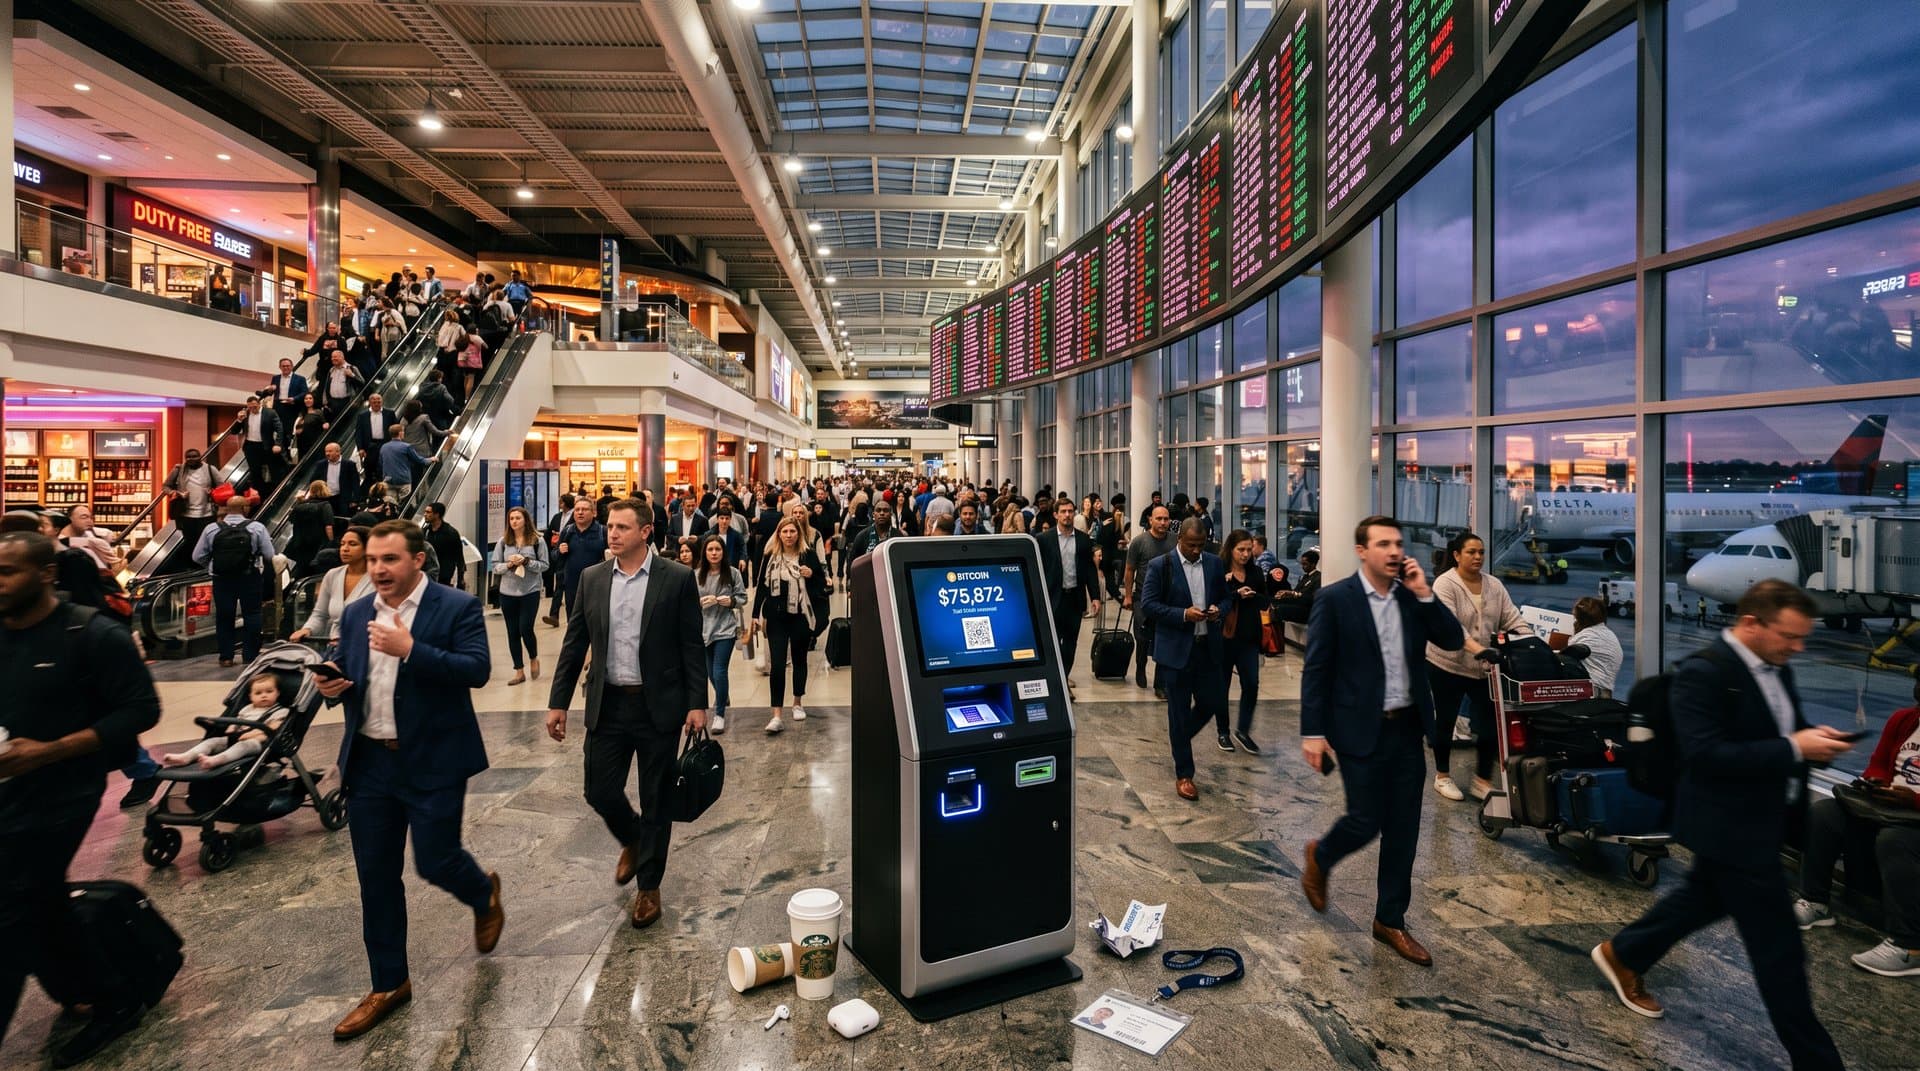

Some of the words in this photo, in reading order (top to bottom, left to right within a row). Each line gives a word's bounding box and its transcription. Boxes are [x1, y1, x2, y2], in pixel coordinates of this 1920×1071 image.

[134, 200, 176, 231] DUTY
[178, 217, 212, 245] FREE
[1541, 499, 1593, 508] DELTA
[957, 571, 990, 581] BITCOIN
[938, 586, 1005, 607] $75,872
